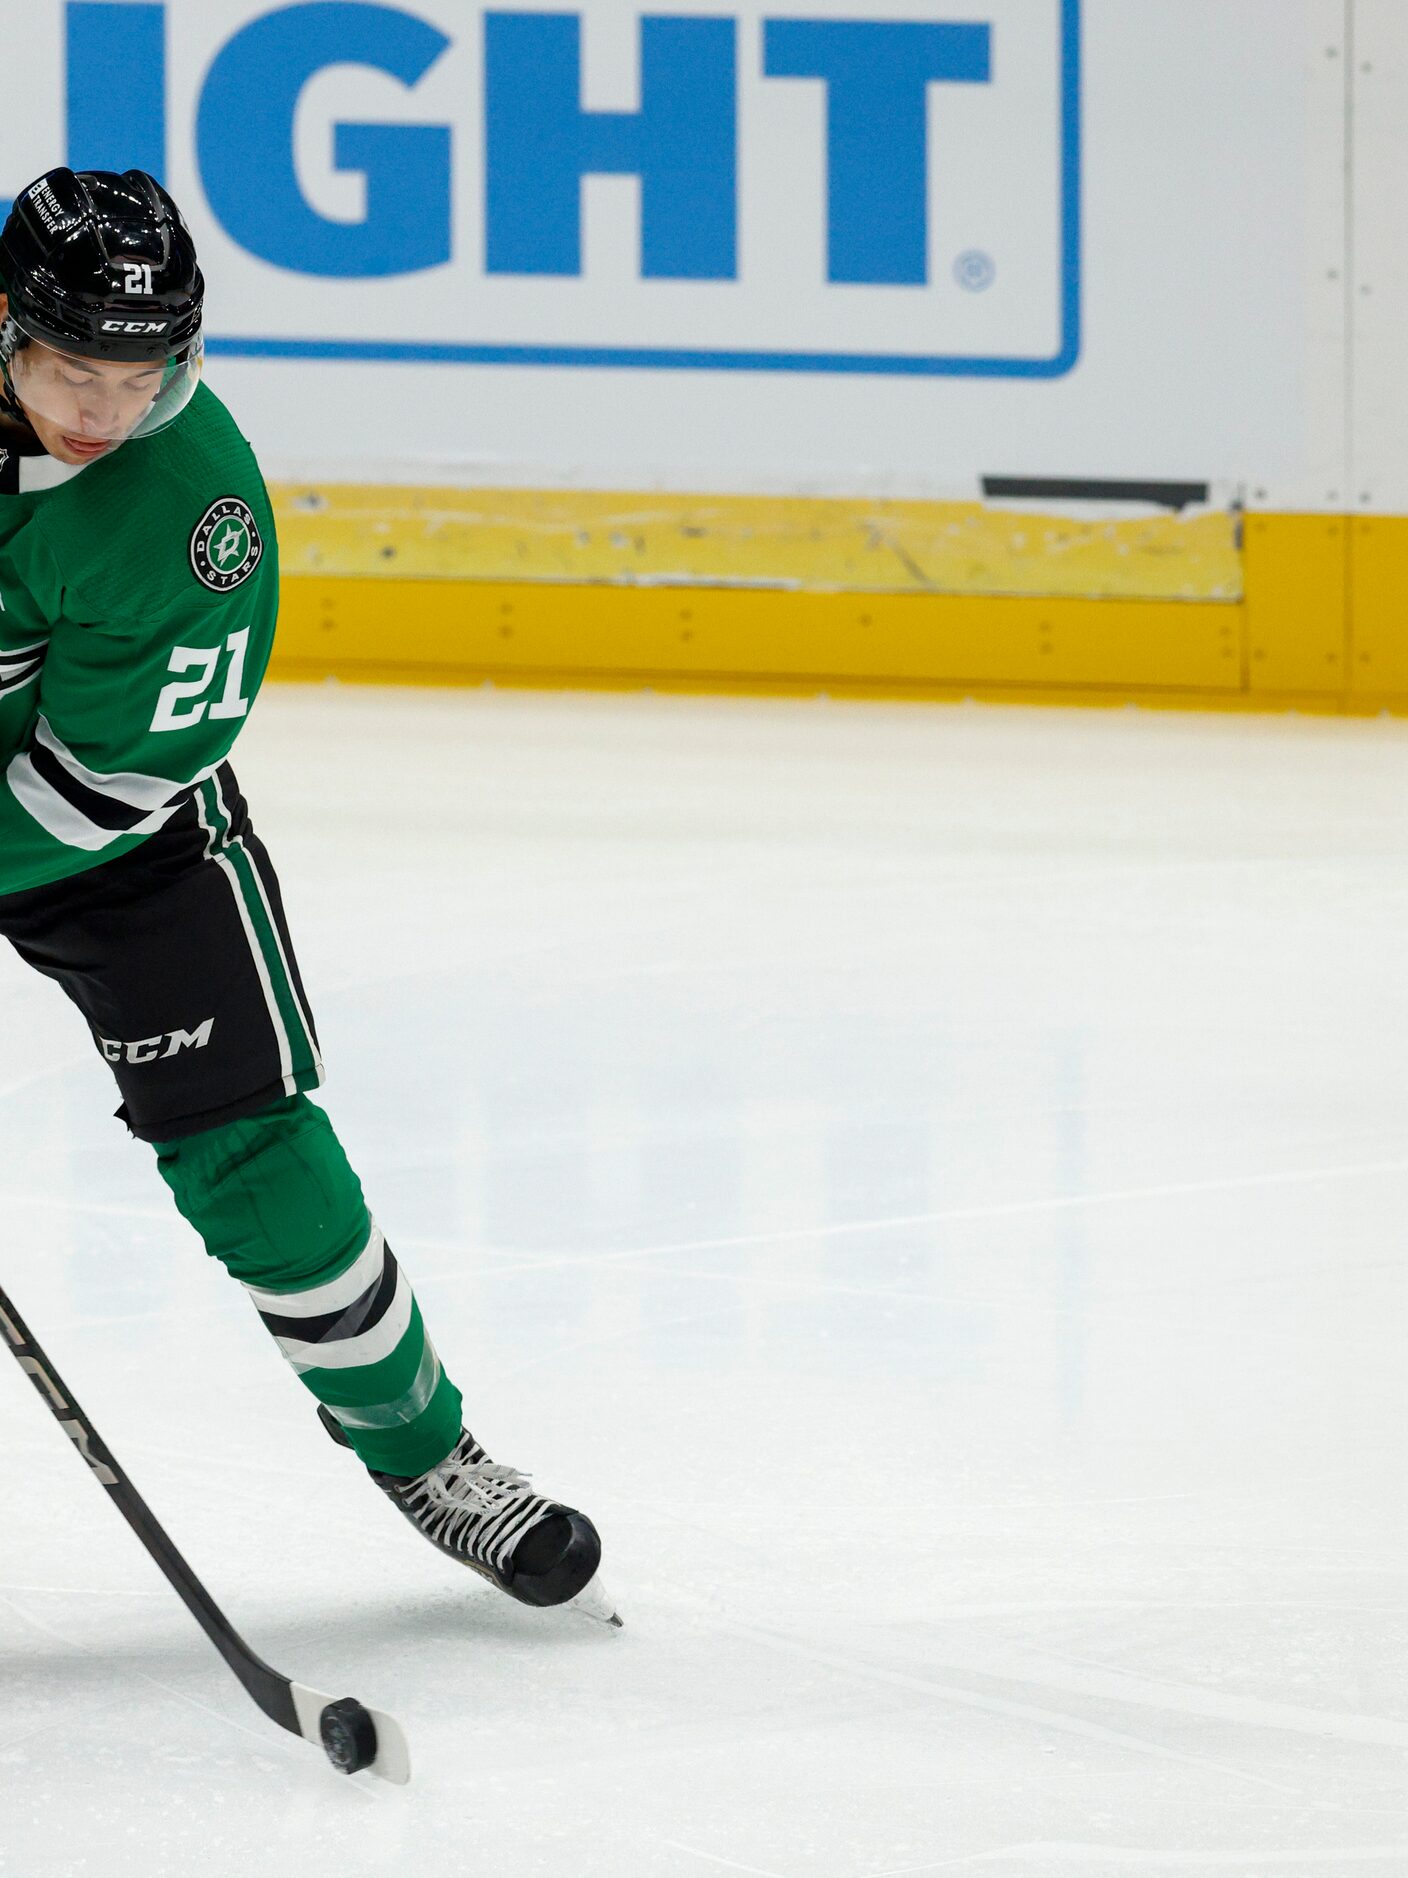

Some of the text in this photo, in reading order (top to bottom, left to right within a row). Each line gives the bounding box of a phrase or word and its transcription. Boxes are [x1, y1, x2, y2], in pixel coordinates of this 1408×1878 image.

[32, 194, 59, 235] TRANSFER
[41, 186, 65, 217] ENERGY
[123, 263, 153, 295] 21
[101, 319, 168, 333] CCM
[196, 505, 252, 554] DALLAS
[206, 545, 259, 585] STARS
[148, 624, 251, 733] 21
[98, 1017, 215, 1064] CCM
